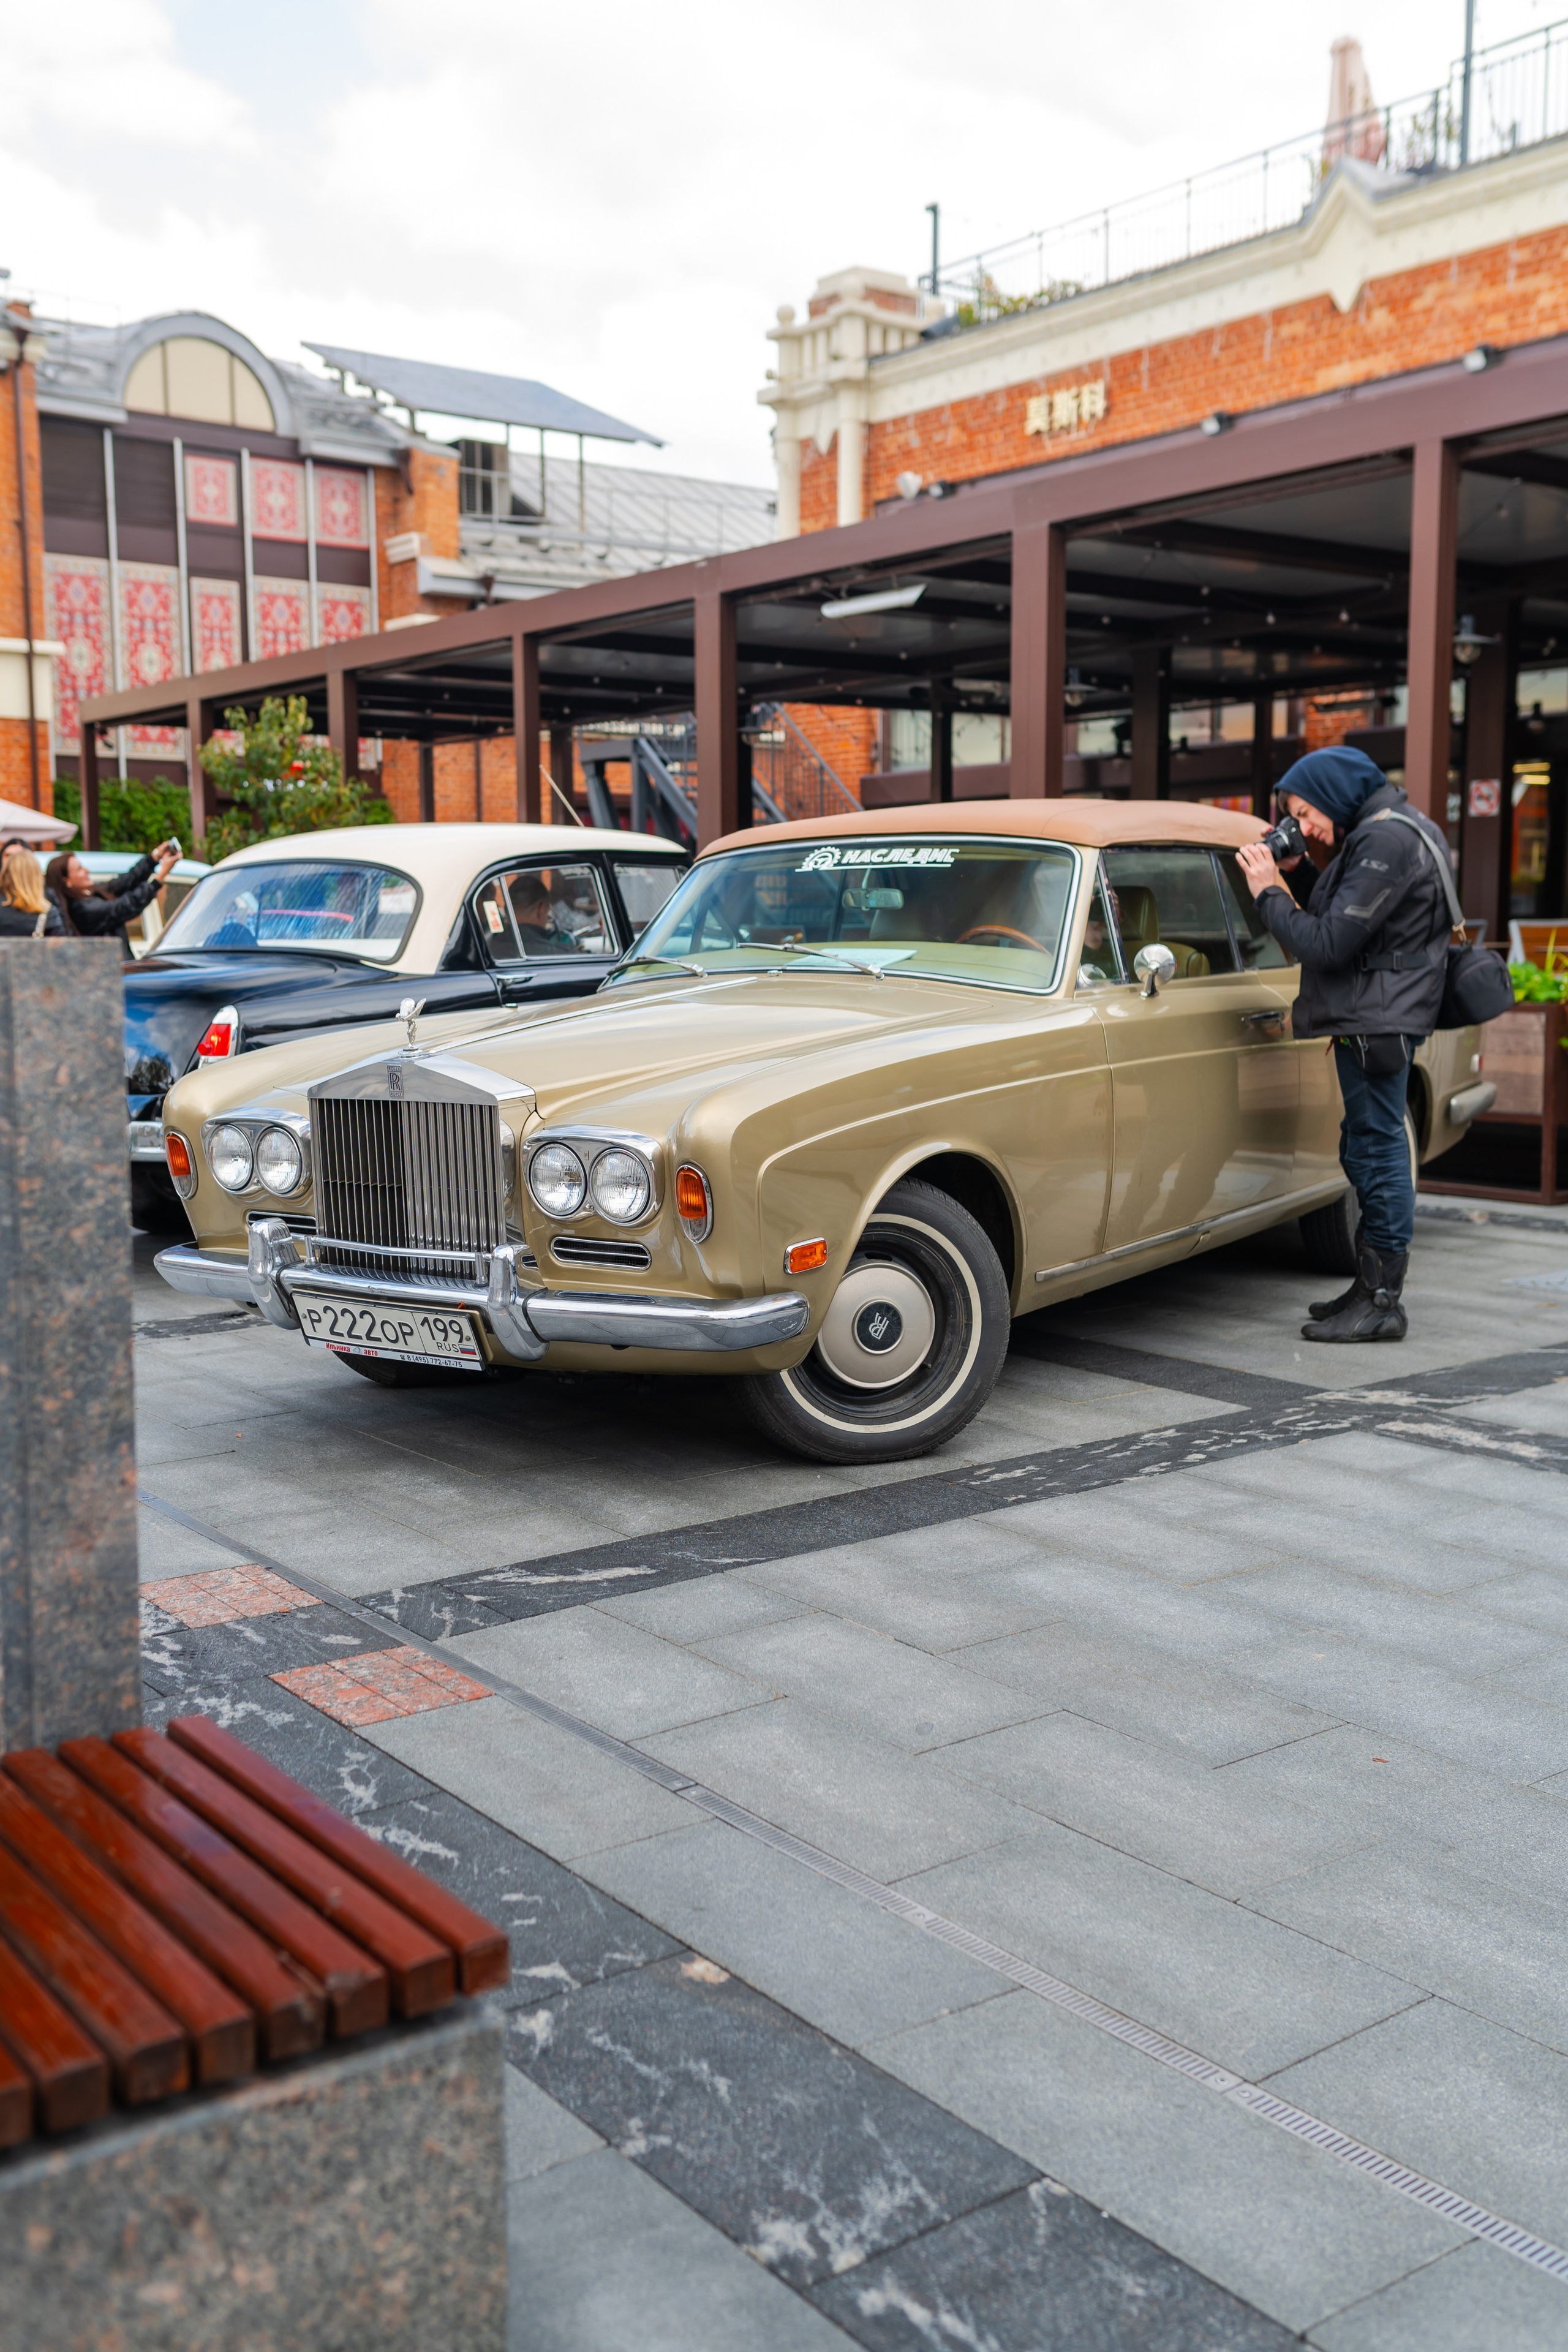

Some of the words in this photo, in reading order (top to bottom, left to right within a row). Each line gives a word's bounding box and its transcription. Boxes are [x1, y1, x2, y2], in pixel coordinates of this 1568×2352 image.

[1024, 379, 1107, 436] 莫斯科
[841, 848, 960, 864] НАСЛЕДИЕ
[1360, 858, 1389, 872] LS2
[420, 1316, 464, 1343] 199
[325, 1342, 350, 1352] Ильинка
[436, 1341, 459, 1353] RUS
[412, 1355, 429, 1364] (495)
[430, 1357, 463, 1368] 772-67-75
